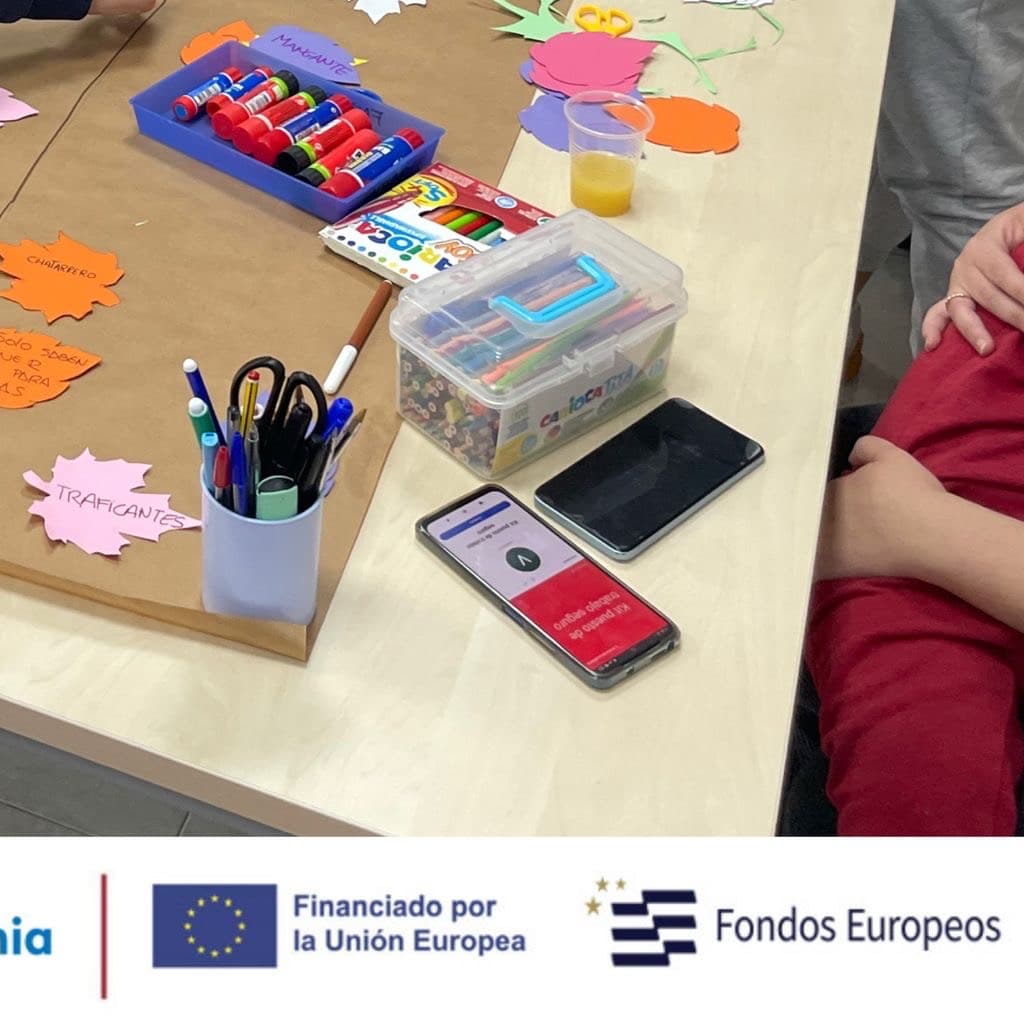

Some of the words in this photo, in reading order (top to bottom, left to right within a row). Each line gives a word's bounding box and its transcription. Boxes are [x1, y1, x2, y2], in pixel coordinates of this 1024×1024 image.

[275, 33, 354, 76] MANGANTE
[353, 220, 457, 272] ARIOCA
[39, 347, 89, 367] SABEN
[12, 368, 50, 388] PARA
[56, 484, 185, 529] TRAFICANTES
[552, 606, 587, 630] seguro
[582, 607, 614, 633] puesto
[568, 628, 584, 641] de
